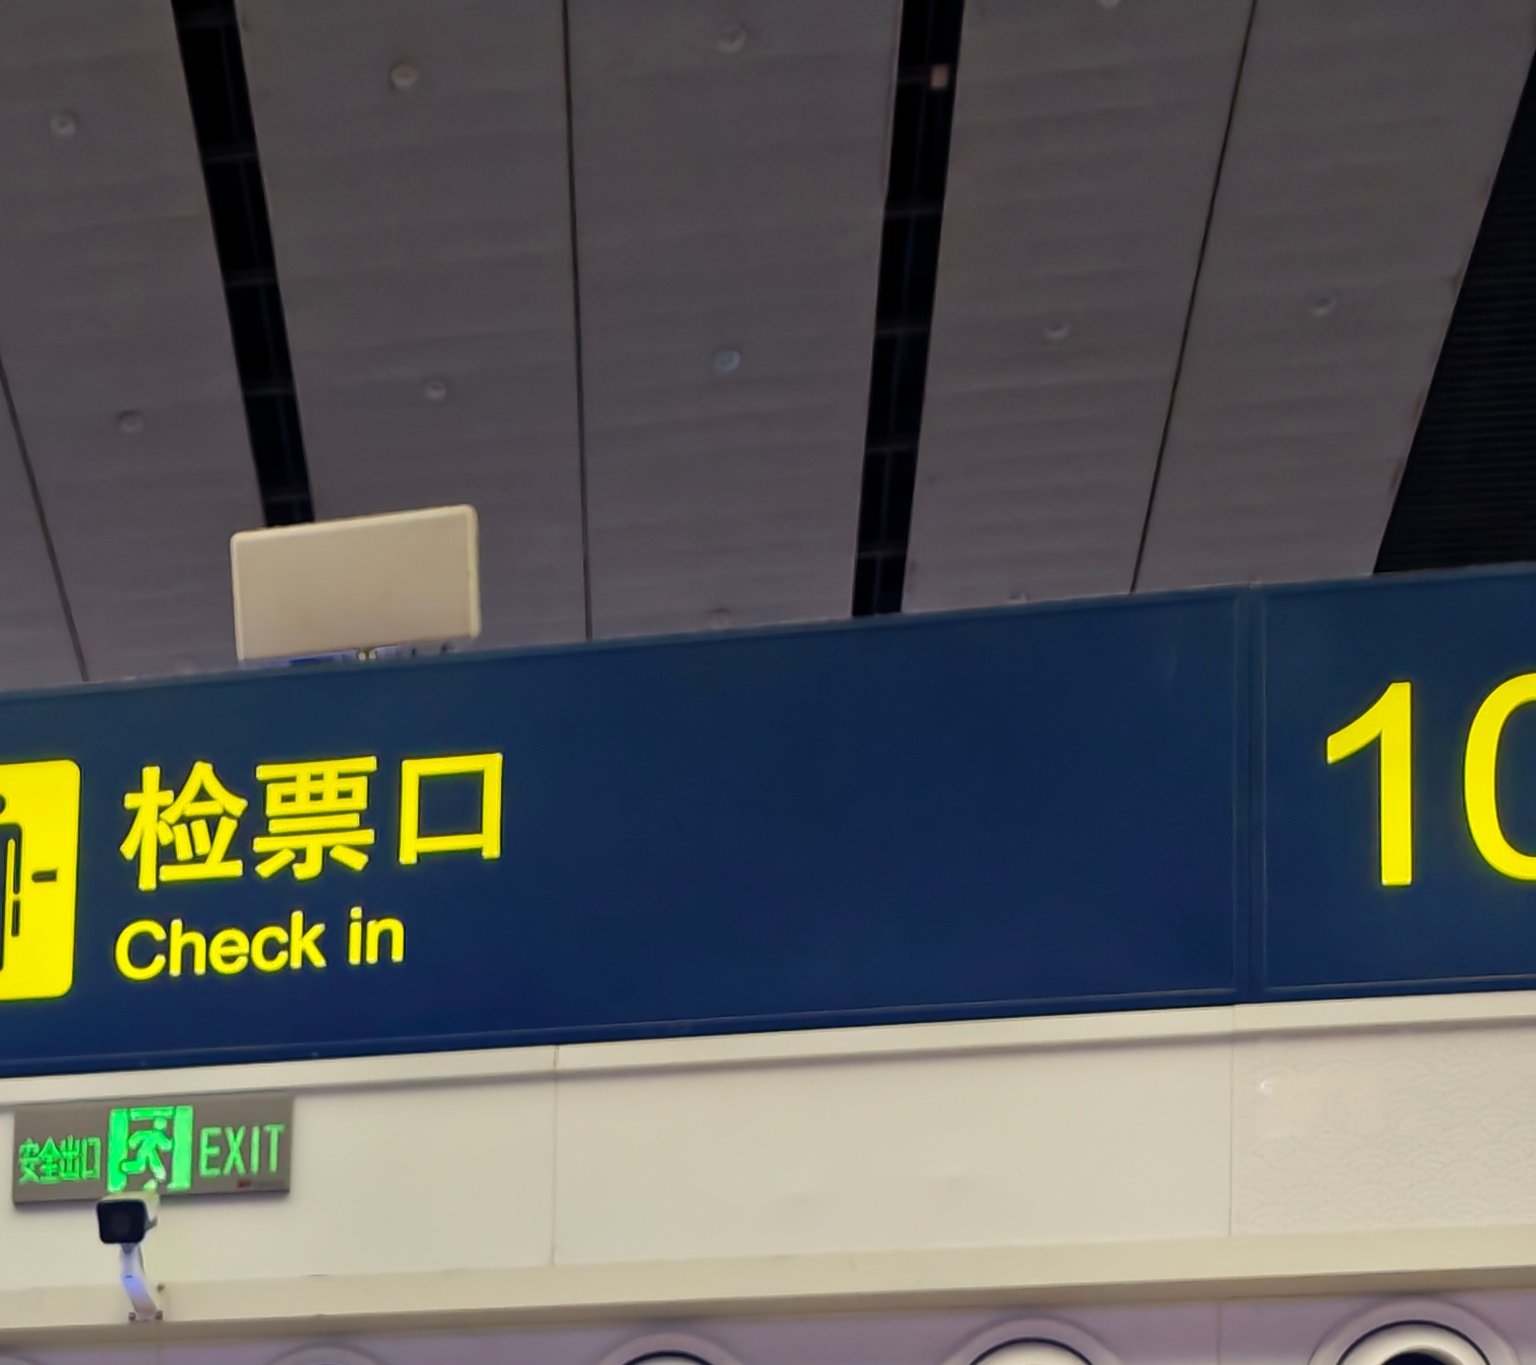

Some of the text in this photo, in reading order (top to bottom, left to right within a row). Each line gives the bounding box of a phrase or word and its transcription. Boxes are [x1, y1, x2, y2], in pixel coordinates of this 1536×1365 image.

[119, 752, 503, 892] 检票口
[114, 906, 405, 980] Check in
[18, 1135, 102, 1184] 安全出口
[198, 1123, 286, 1178] EXIT
